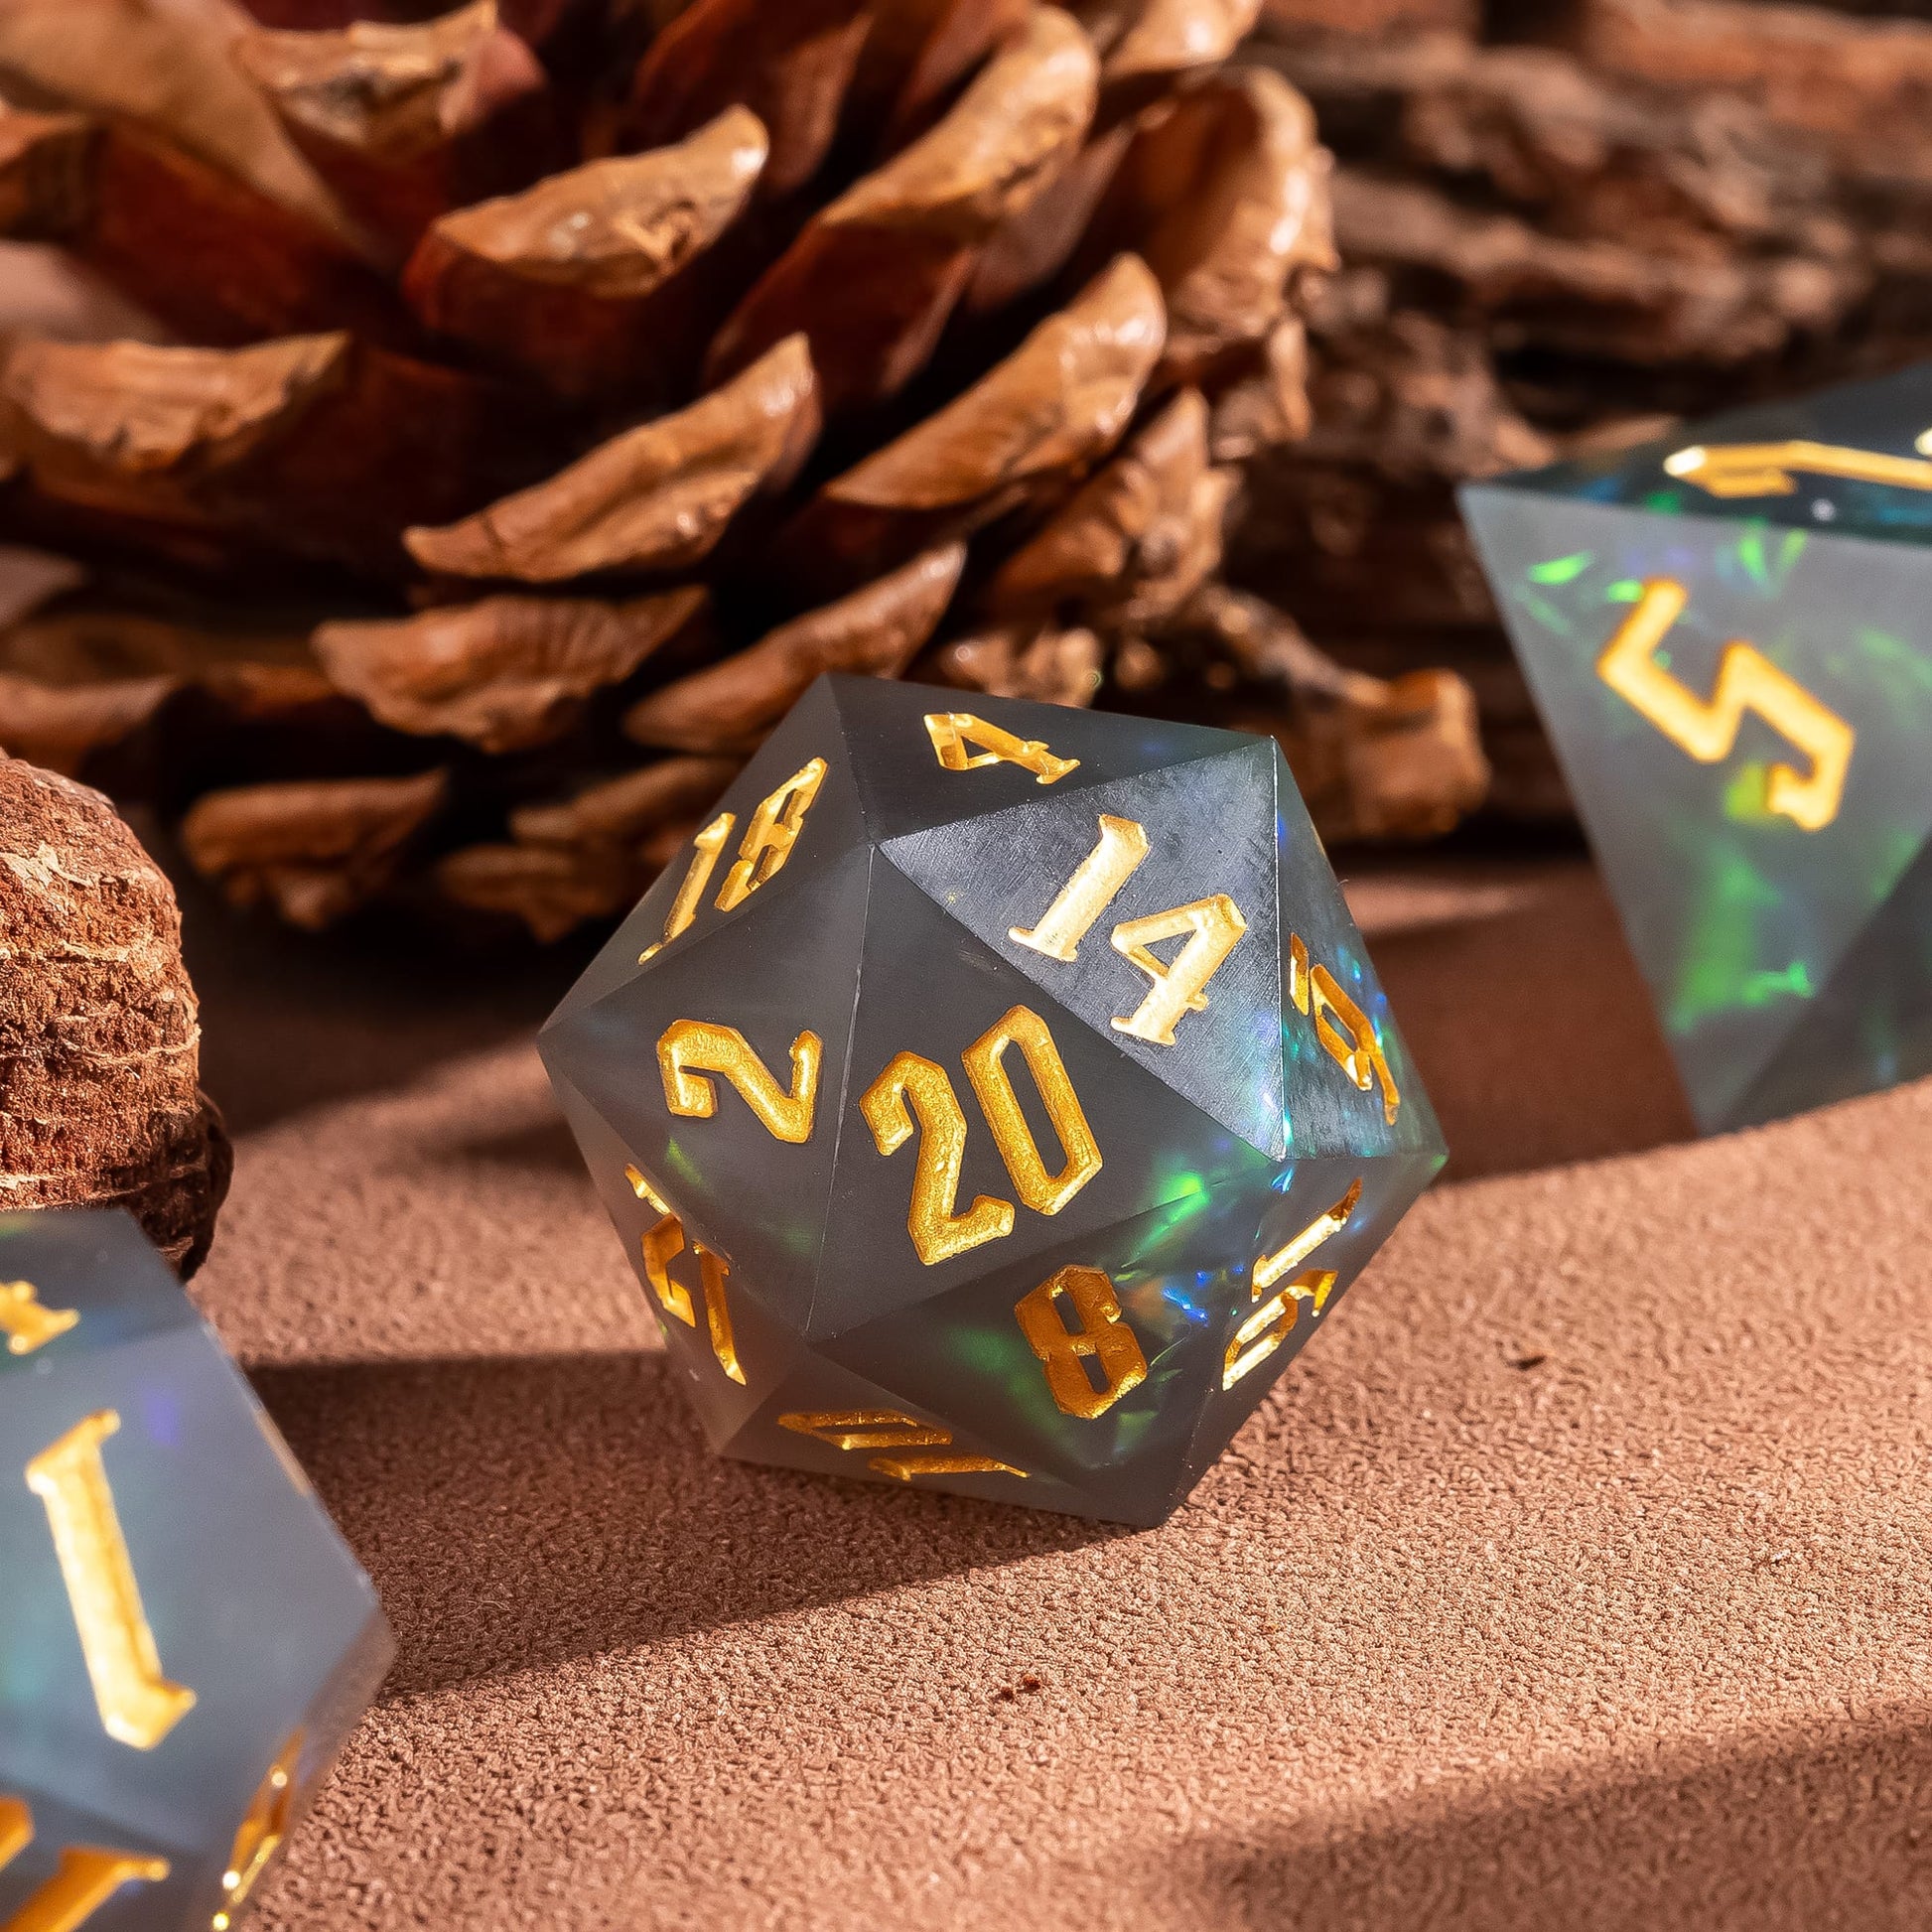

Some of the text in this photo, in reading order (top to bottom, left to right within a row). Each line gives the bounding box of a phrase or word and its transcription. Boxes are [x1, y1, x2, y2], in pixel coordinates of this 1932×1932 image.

[923, 713, 1080, 784] 4
[1596, 577, 1855, 832] 5
[637, 757, 828, 965] 18
[1009, 814, 1247, 1045] 14
[656, 1019, 823, 1144] 2
[860, 1005, 1103, 1266] 20
[1015, 1264, 1148, 1420] 8
[27, 1410, 197, 1749] 1
